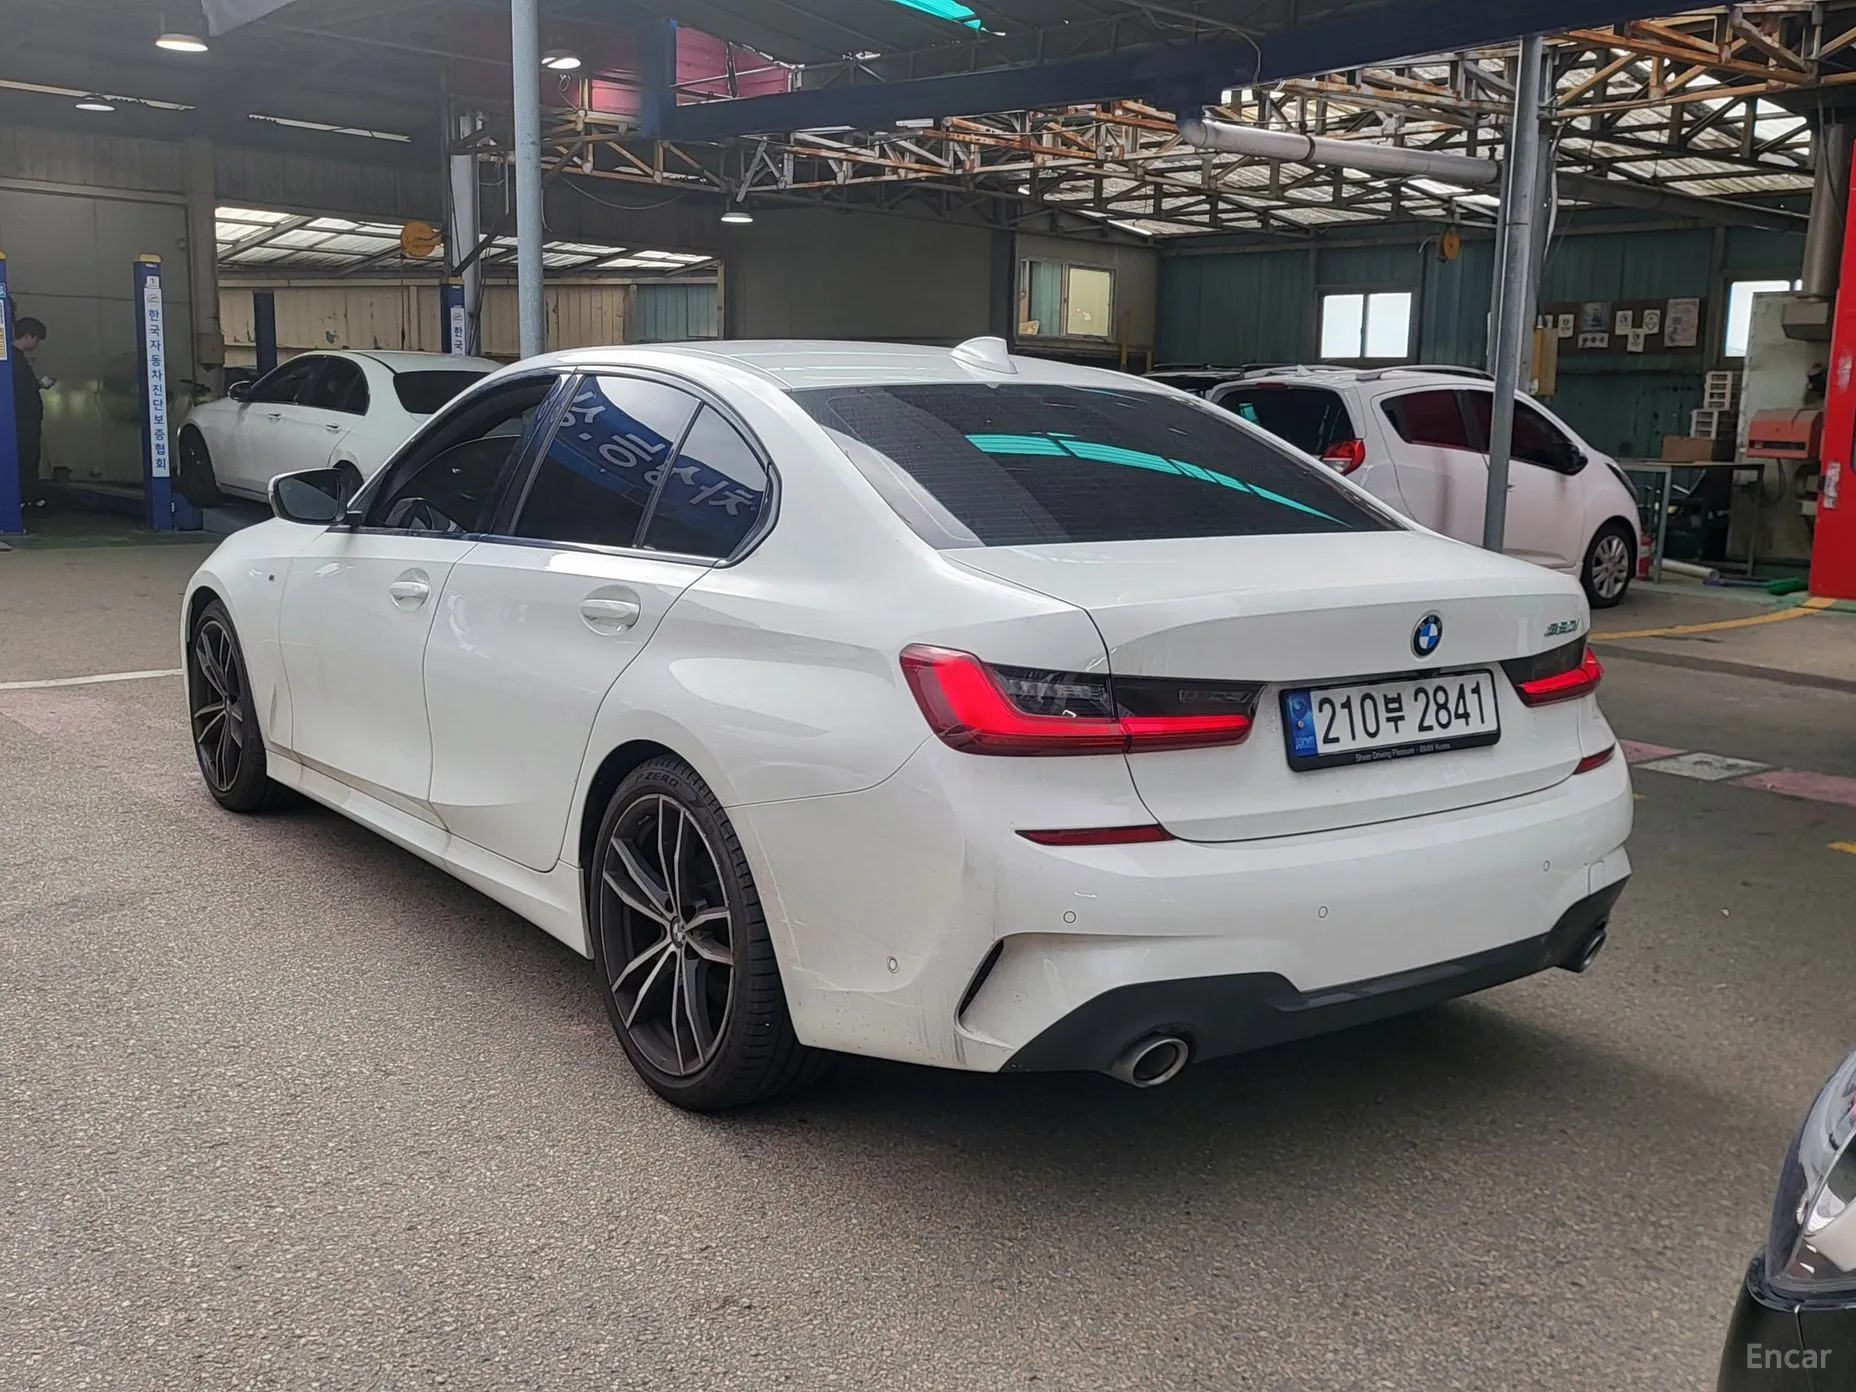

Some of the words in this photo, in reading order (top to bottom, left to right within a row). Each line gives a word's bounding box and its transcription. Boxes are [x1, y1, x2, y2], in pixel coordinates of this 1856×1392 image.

[454, 326, 463, 354] 한국
[148, 308, 167, 471] 한국자동차진단보증협회
[1317, 691, 1406, 745] 210부
[1413, 680, 1486, 733] 2841
[644, 771, 680, 788] ZERO
